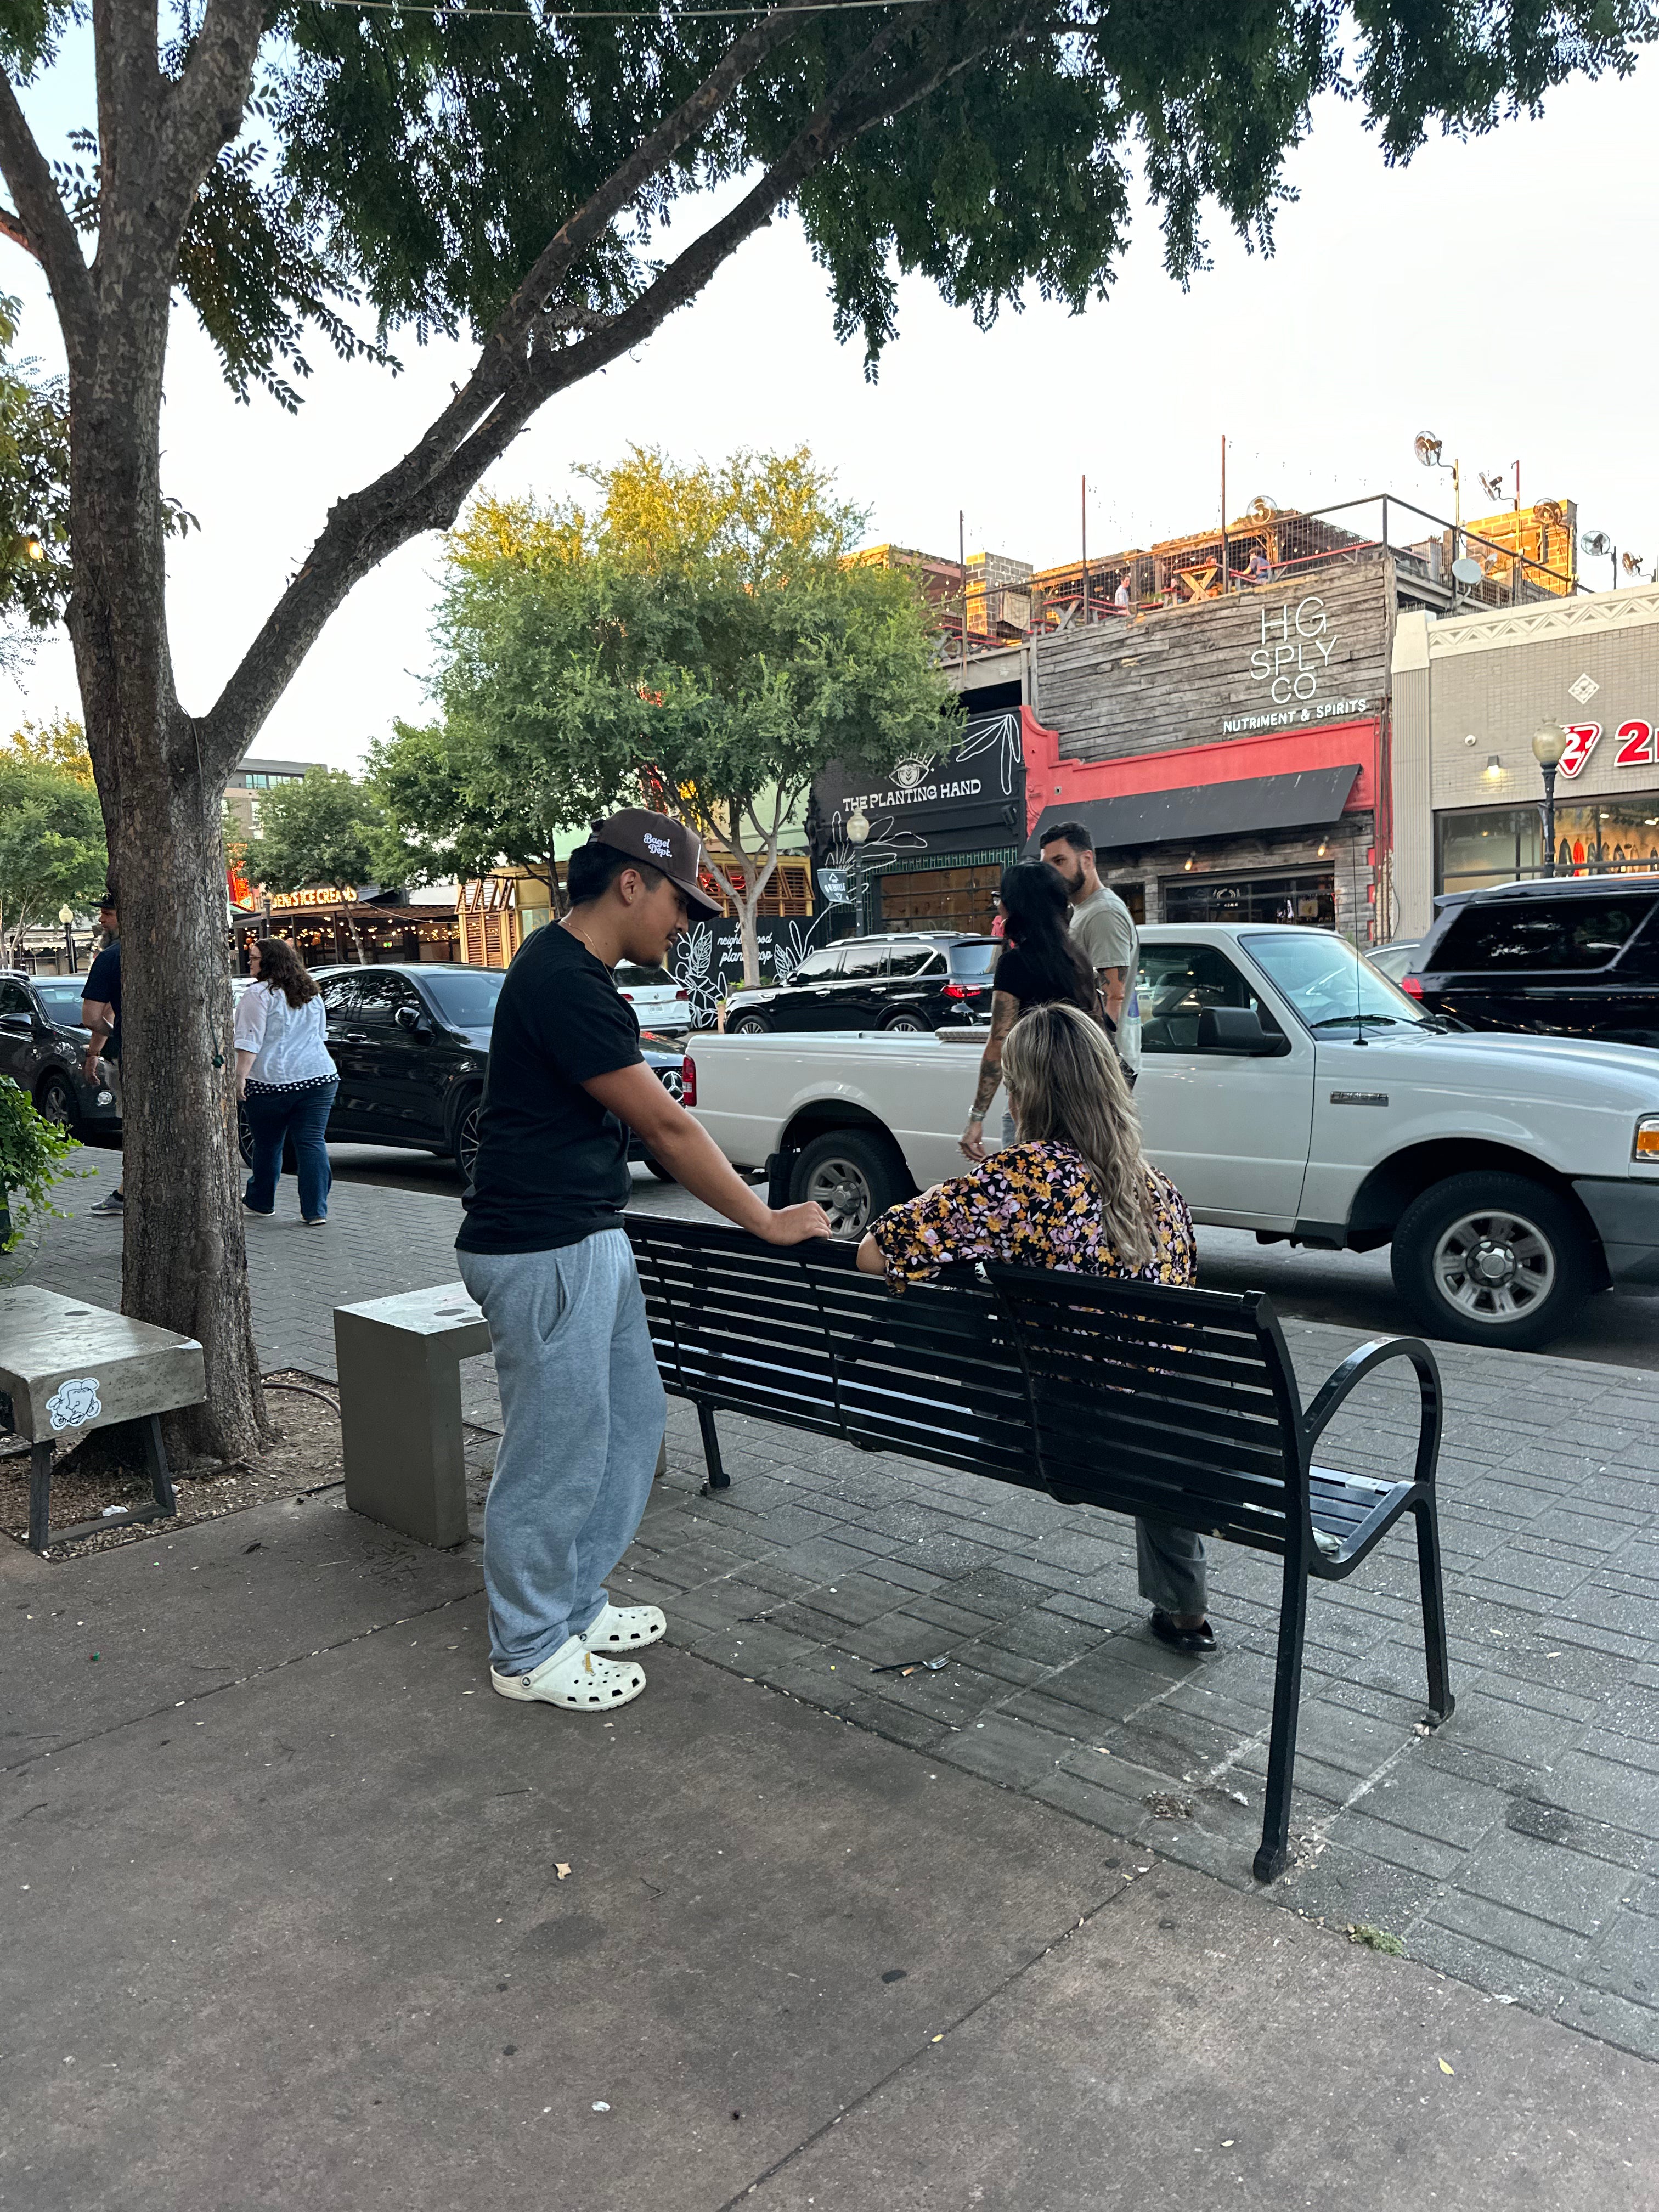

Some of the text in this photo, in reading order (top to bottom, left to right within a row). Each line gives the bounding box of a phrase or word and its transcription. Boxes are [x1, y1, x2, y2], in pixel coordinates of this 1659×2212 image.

[1261, 596, 1327, 645] HG
[1250, 635, 1338, 680] SPLY
[1271, 673, 1316, 704] CO
[1223, 698, 1367, 733] NUTRIMENT & SPIRITS
[1614, 719, 1659, 767] 2
[842, 778, 981, 812] THE PLANTING HAND
[643, 833, 670, 848] Bagel
[648, 843, 673, 858] Dept.
[300, 889, 316, 906] ICE
[719, 947, 745, 967] plan
